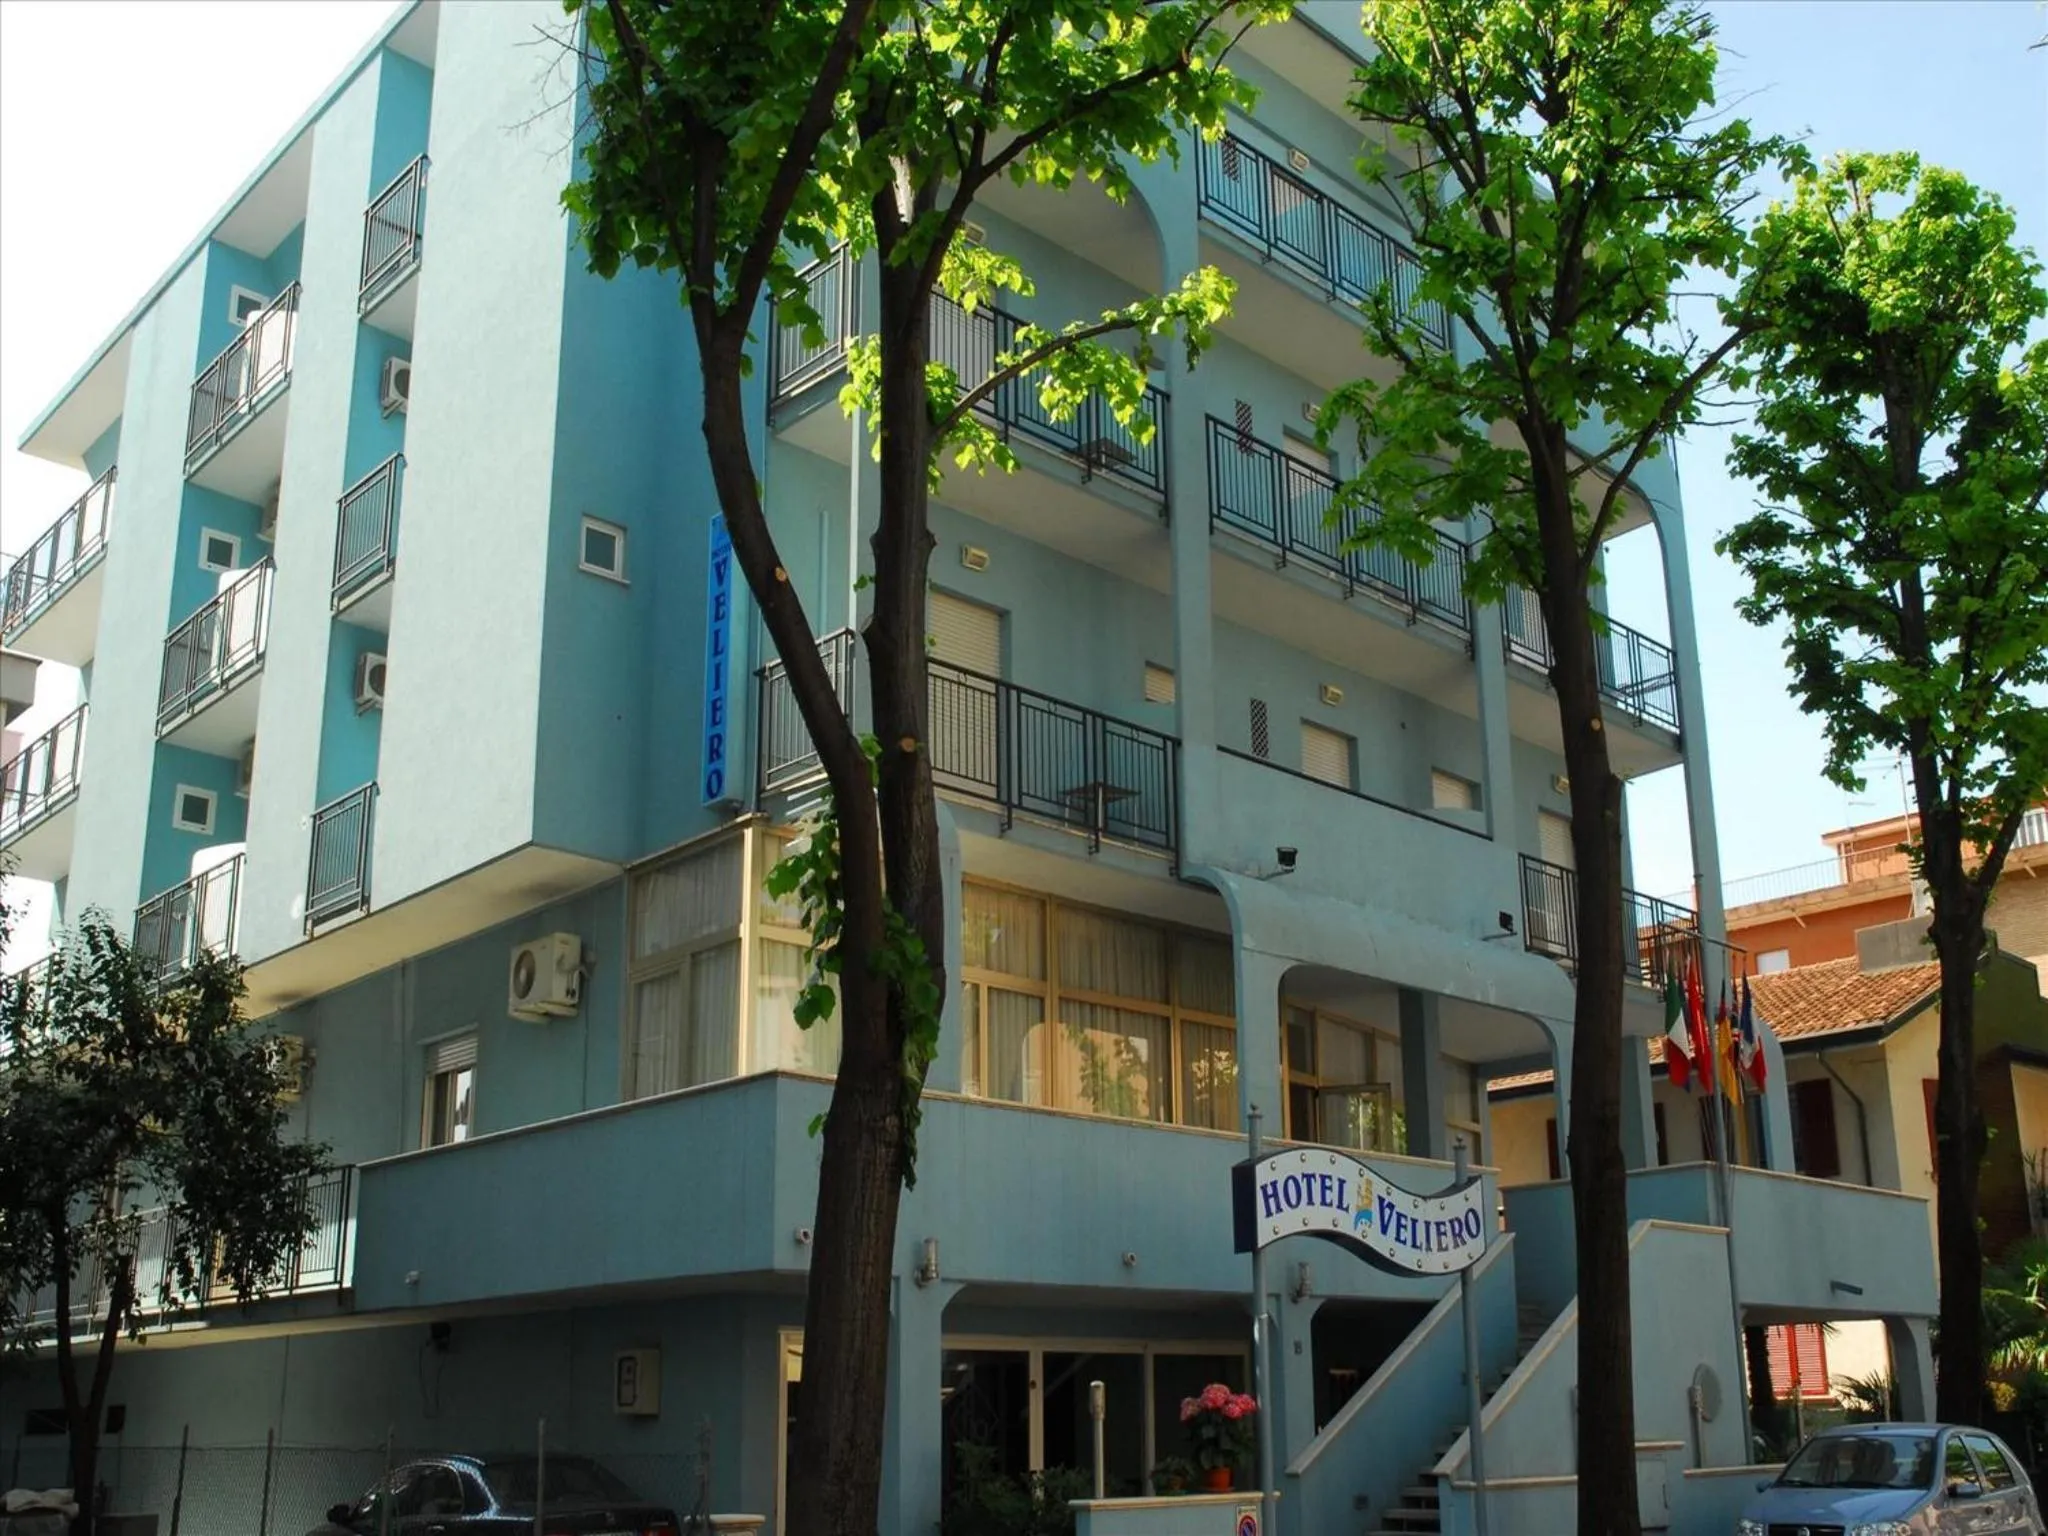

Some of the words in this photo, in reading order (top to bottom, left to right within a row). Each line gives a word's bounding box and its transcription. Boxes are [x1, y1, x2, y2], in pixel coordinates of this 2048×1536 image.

[706, 556, 728, 799] VELIERO
[1260, 1172, 1350, 1218] HOTEL
[1377, 1194, 1481, 1253] VELIERO
